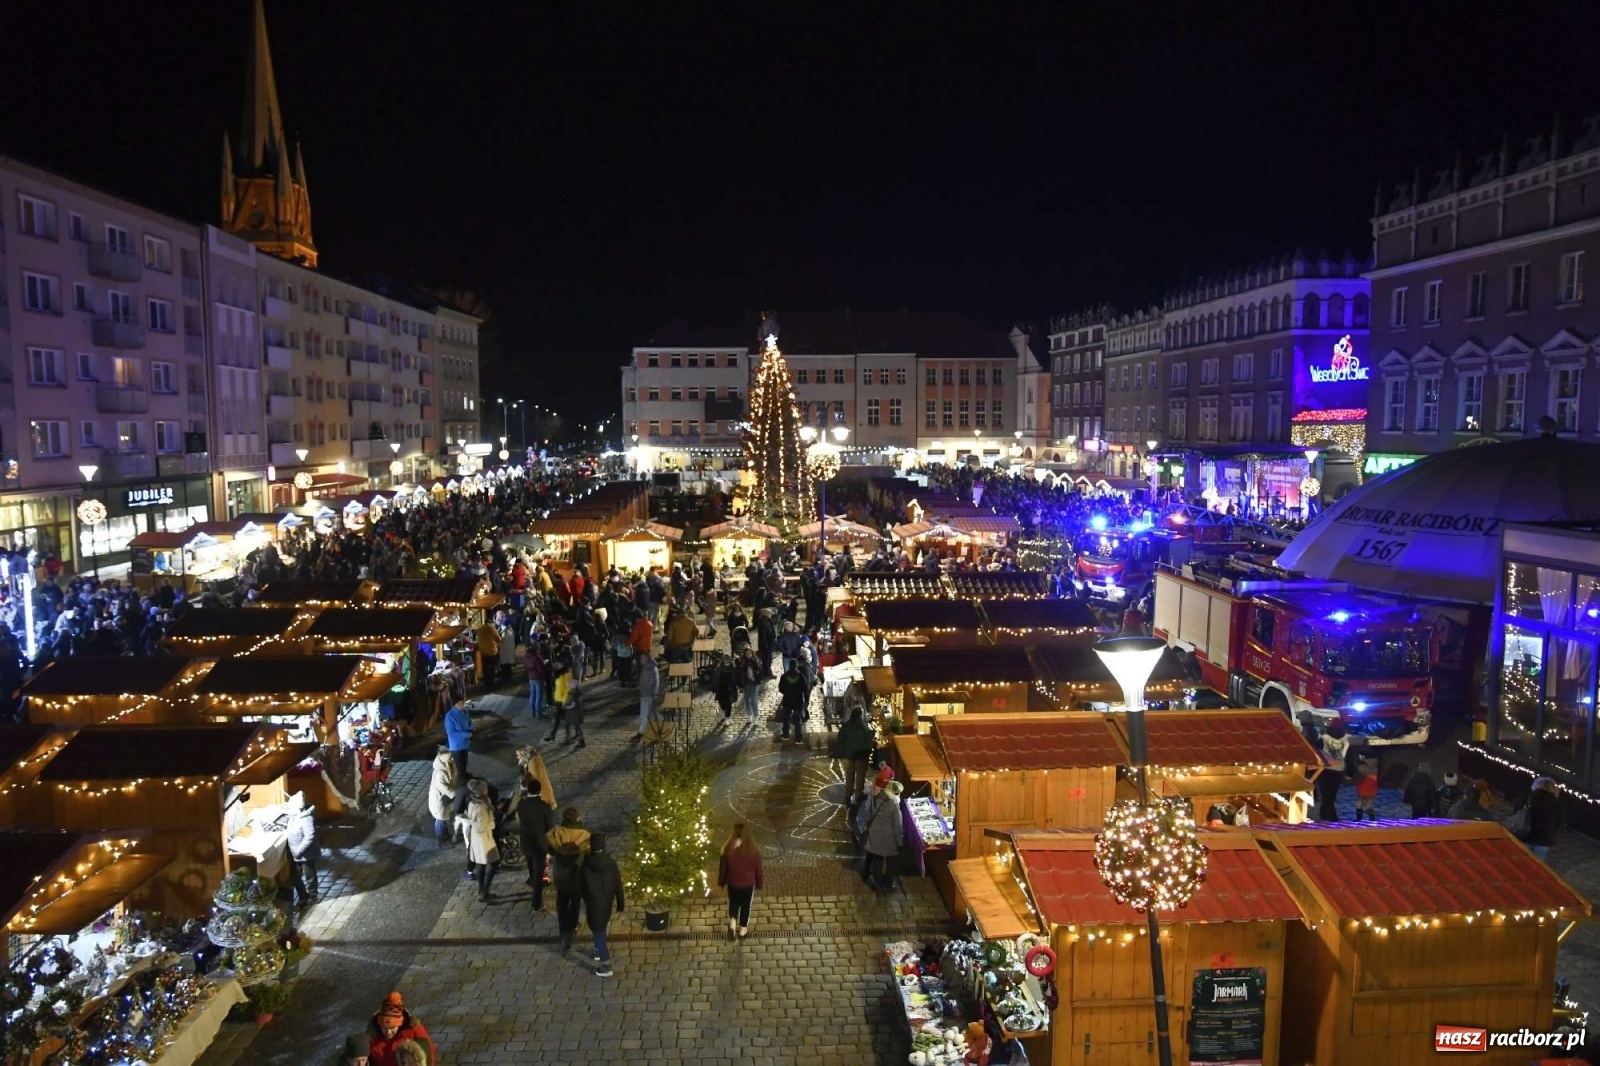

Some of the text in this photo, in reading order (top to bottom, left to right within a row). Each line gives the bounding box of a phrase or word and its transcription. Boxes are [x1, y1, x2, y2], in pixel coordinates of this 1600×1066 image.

[128, 487, 174, 502] JUBILER
[1393, 512, 1501, 537] RACIBÓRZ
[1354, 538, 1408, 562] 1567
